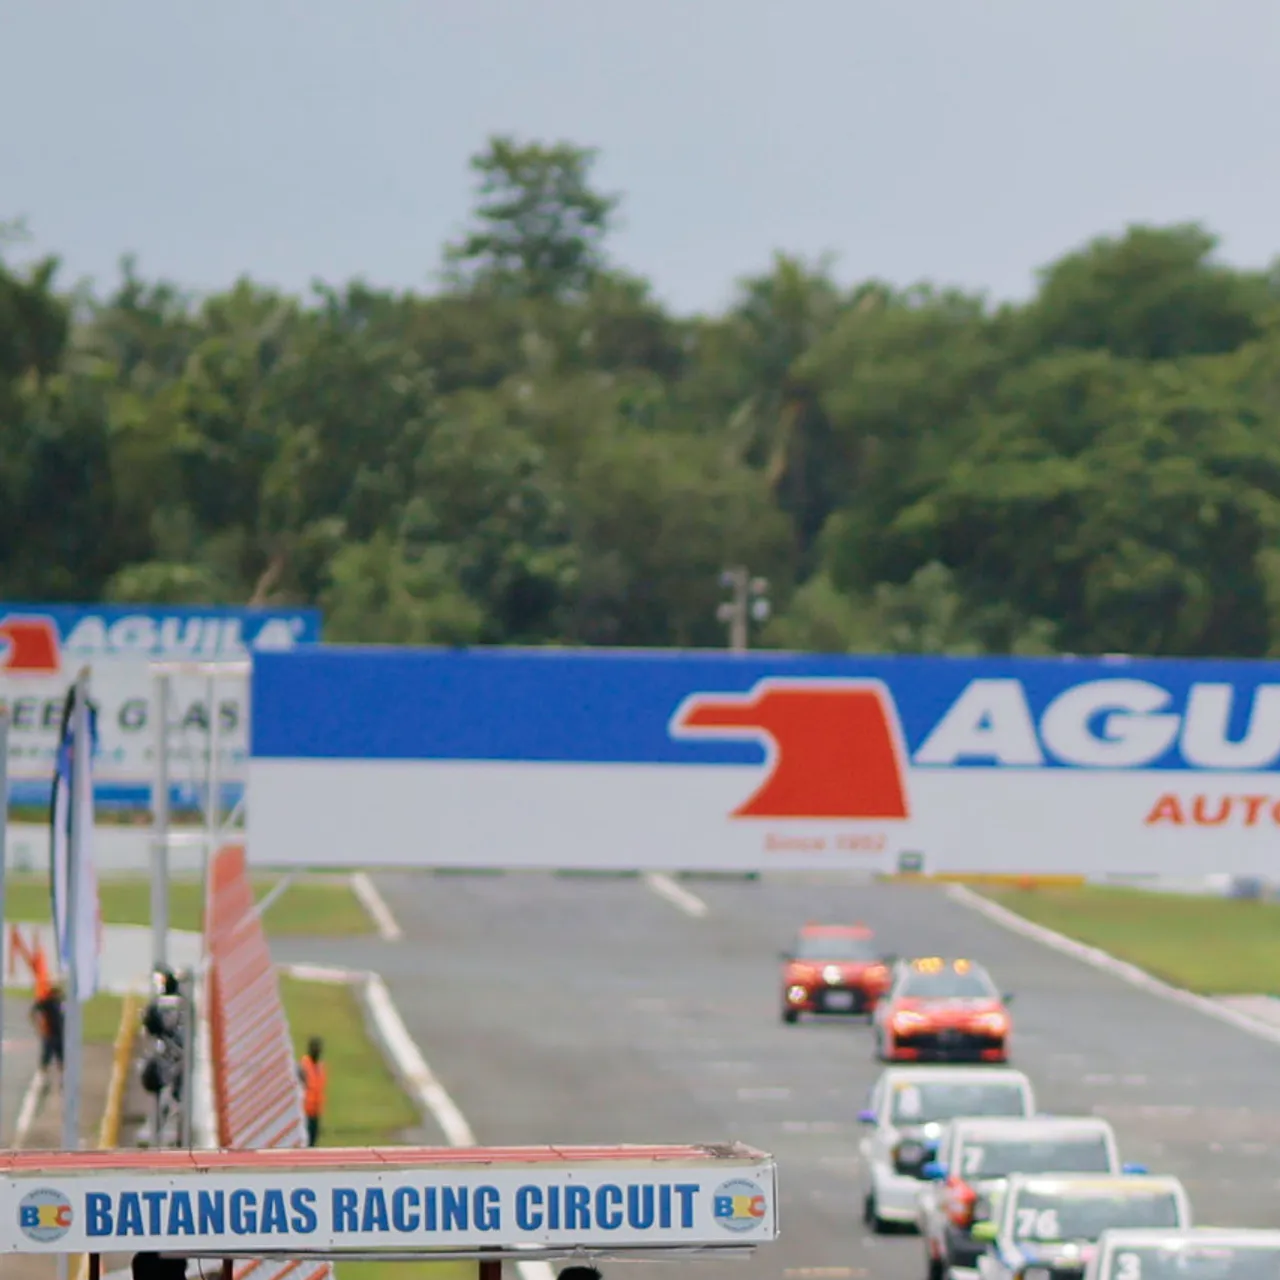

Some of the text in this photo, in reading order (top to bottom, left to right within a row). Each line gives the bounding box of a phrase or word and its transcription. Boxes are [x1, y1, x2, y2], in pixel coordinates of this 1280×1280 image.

[85, 1183, 698, 1236] BATANGAS RACING CIRCUIT
[1016, 1209, 1060, 1239] 76
